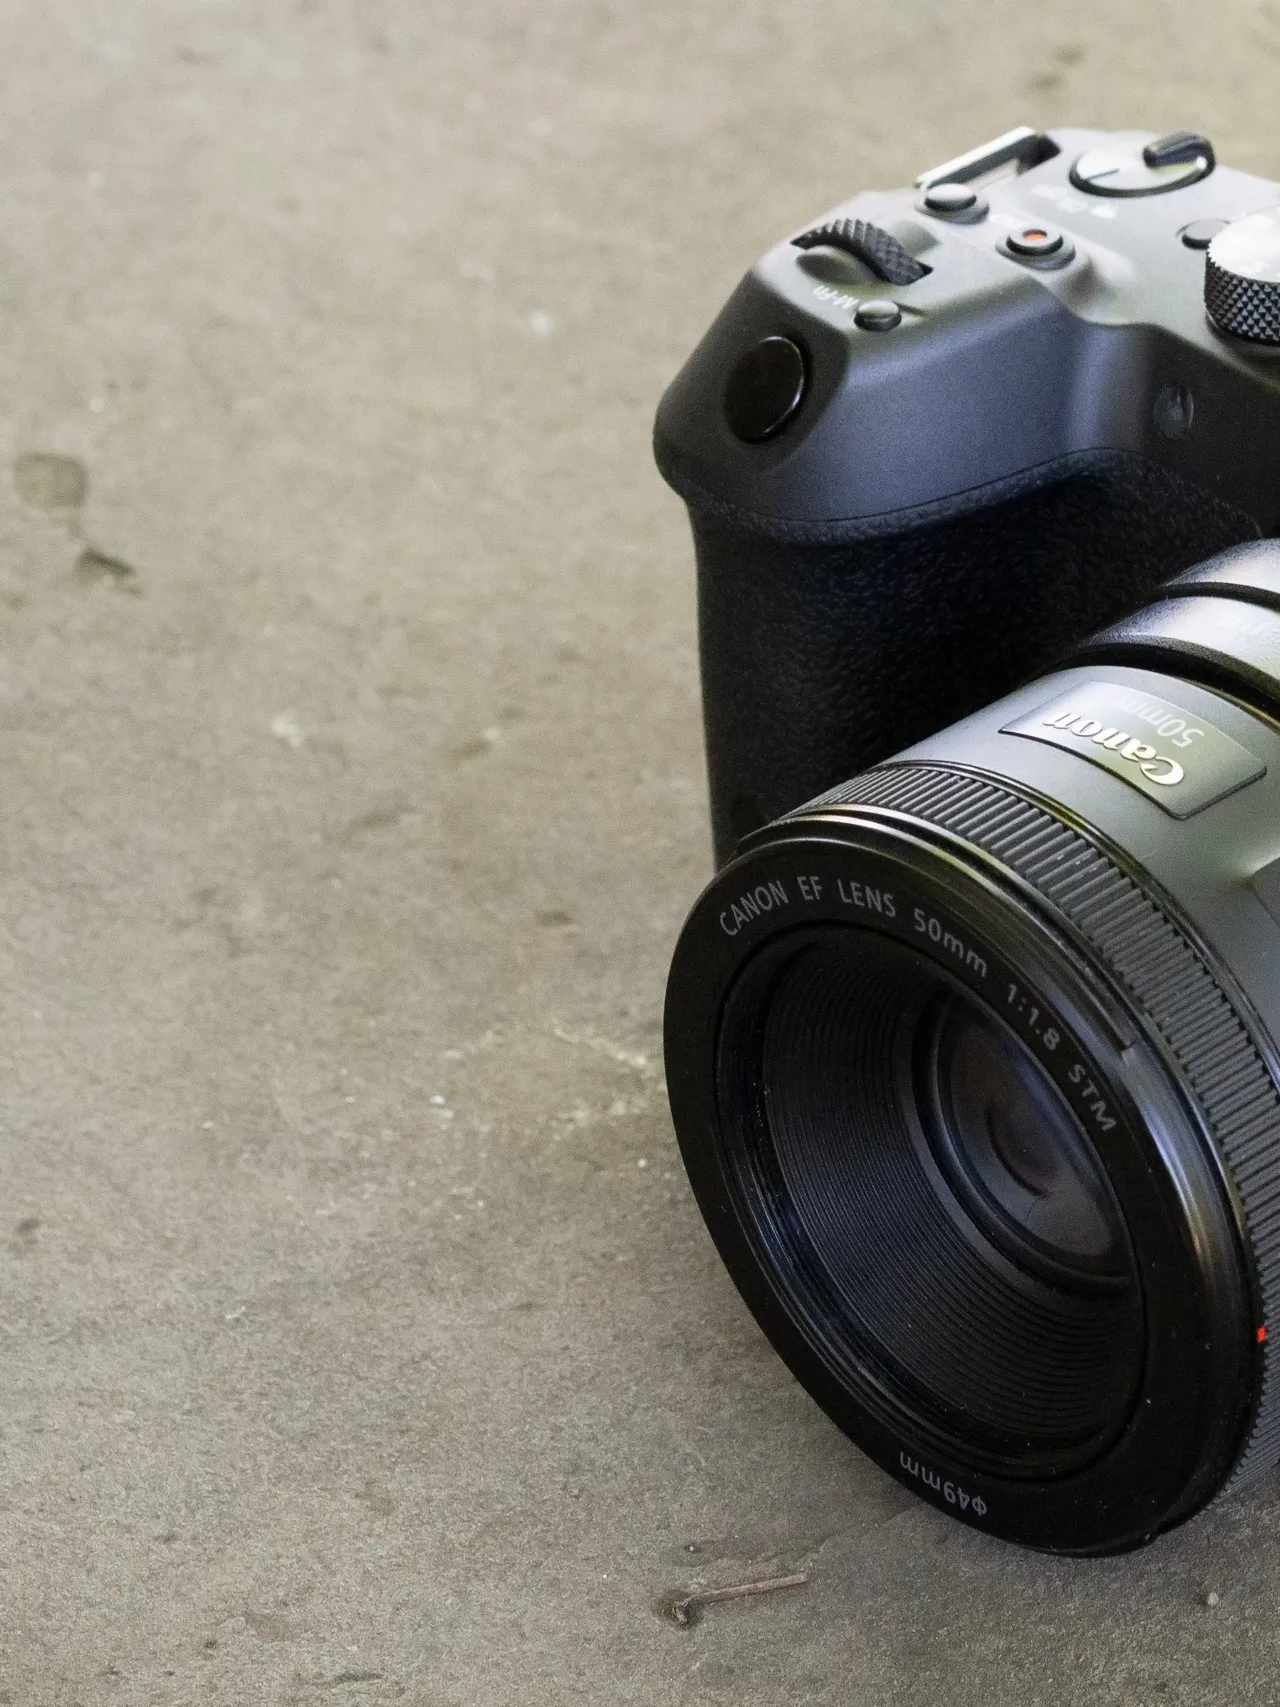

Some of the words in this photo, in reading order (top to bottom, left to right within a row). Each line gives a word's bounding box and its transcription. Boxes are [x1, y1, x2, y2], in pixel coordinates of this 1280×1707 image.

[1042, 711, 1185, 786] Canon
[718, 879, 790, 937] CANON
[796, 875, 823, 902] EF
[836, 877, 898, 919] LENS
[912, 906, 989, 979] 50mm
[1002, 983, 1062, 1051] 1:1.8
[1067, 1063, 1117, 1132] STM
